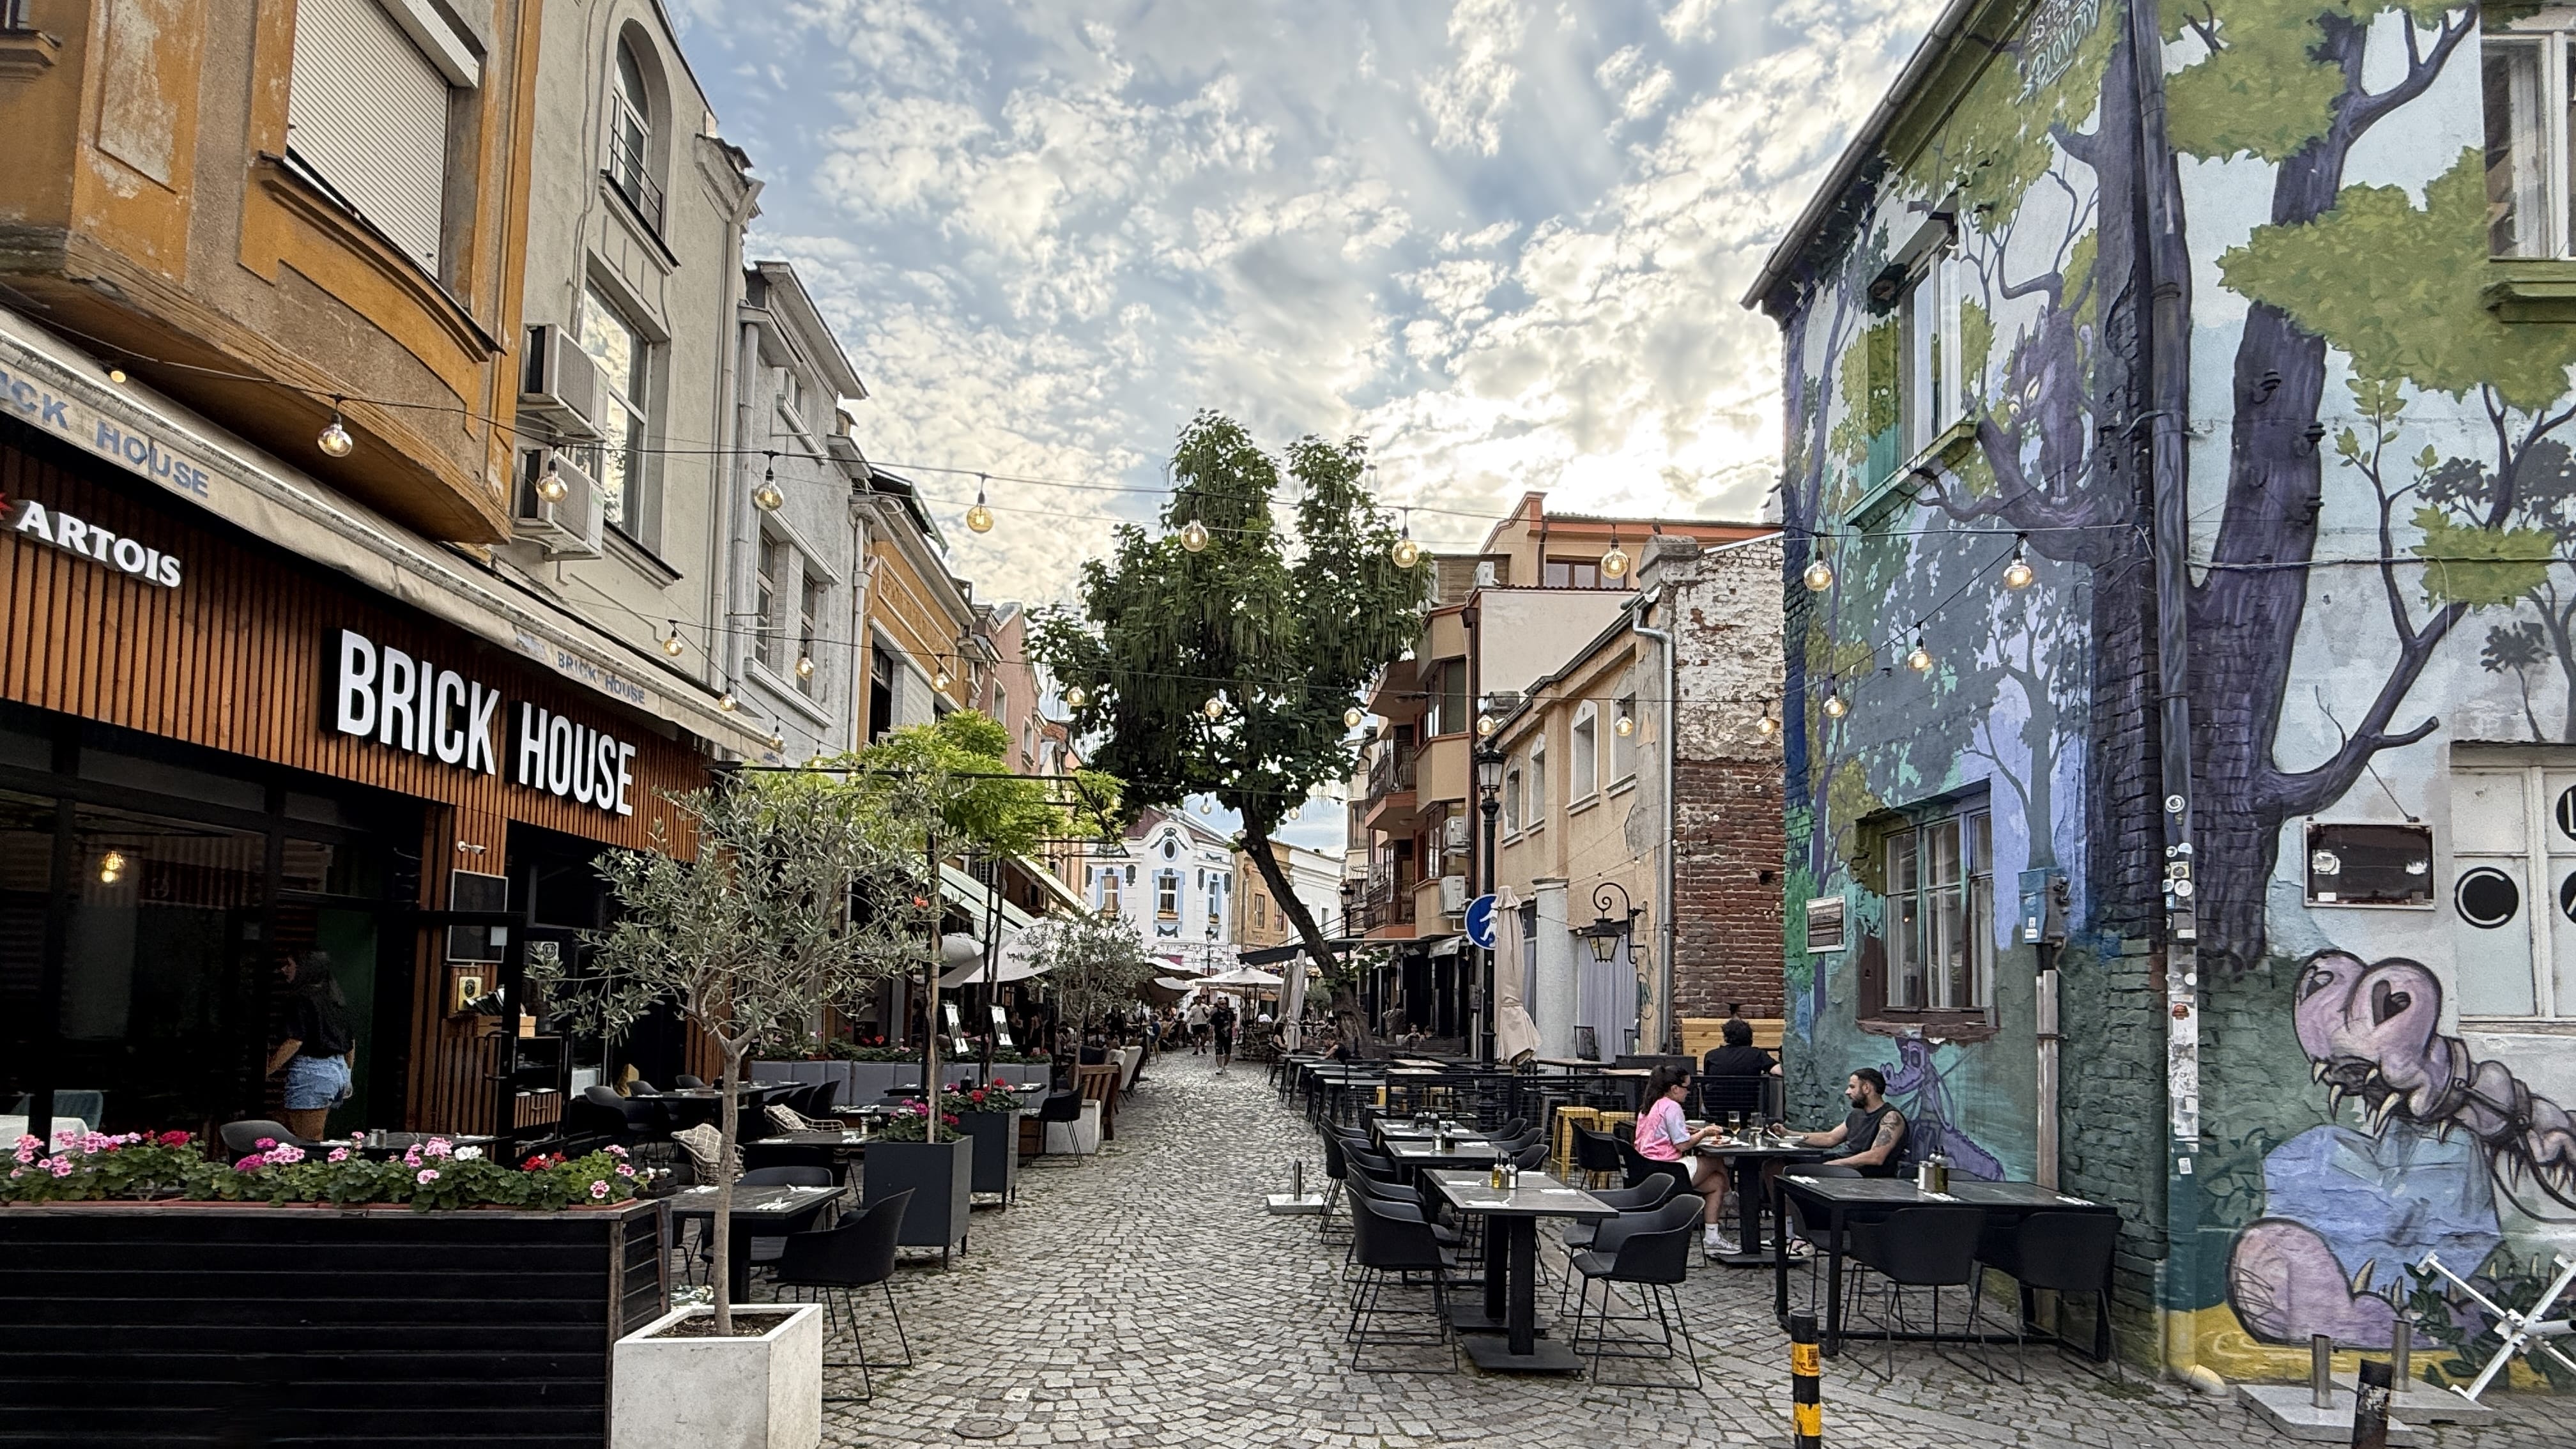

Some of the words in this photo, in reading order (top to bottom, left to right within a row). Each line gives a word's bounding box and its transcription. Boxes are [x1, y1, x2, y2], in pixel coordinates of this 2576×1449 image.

[96, 420, 209, 498] HOUSE
[16, 501, 181, 587] ARTOIS
[557, 650, 597, 684] BRICK
[604, 675, 645, 703] HOUSE
[337, 629, 500, 775] BRICK
[519, 702, 636, 816] HOUSE
